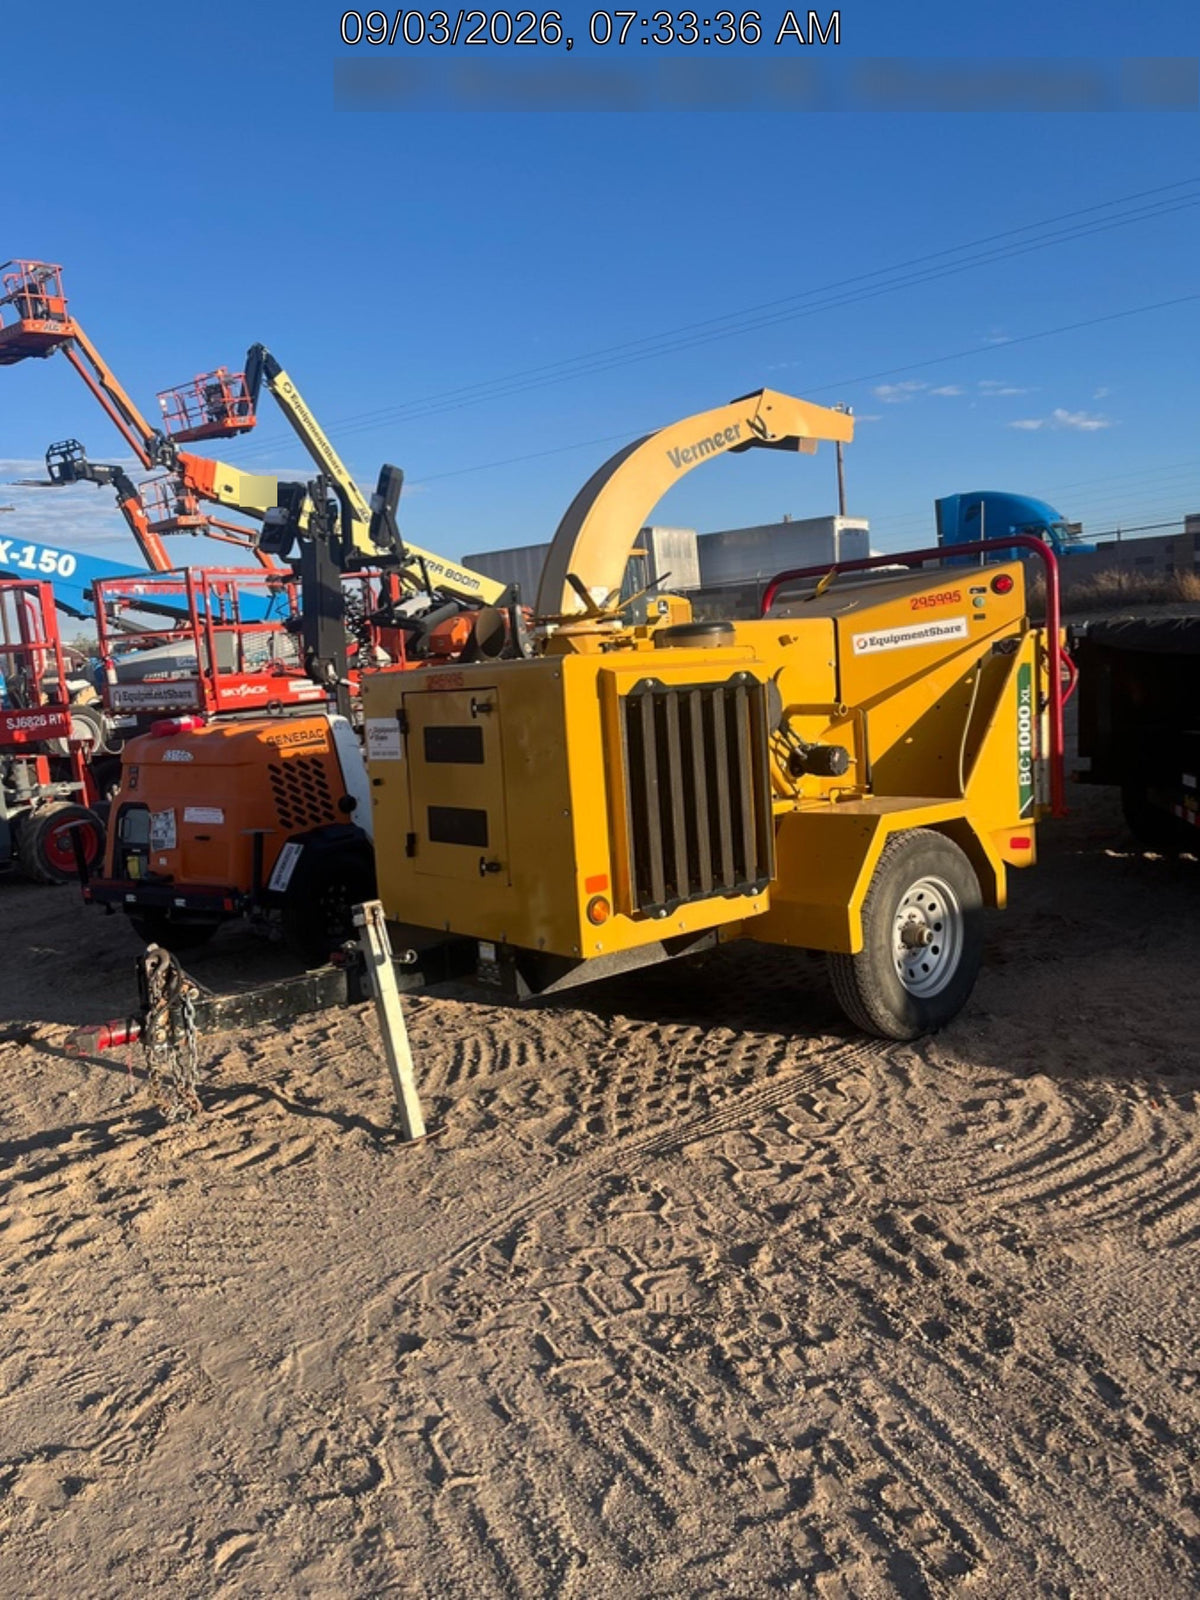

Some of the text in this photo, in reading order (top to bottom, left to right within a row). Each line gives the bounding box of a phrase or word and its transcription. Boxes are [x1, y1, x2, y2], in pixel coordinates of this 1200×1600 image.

[289, 391, 344, 476] EquipmentShare
[665, 424, 742, 469] Vermeer
[910, 590, 962, 611] 295995
[868, 623, 962, 648] EquipmentShare
[1020, 684, 1031, 703] XL
[6, 713, 66, 730] SJ6826 RT
[266, 728, 325, 747] GENERAC
